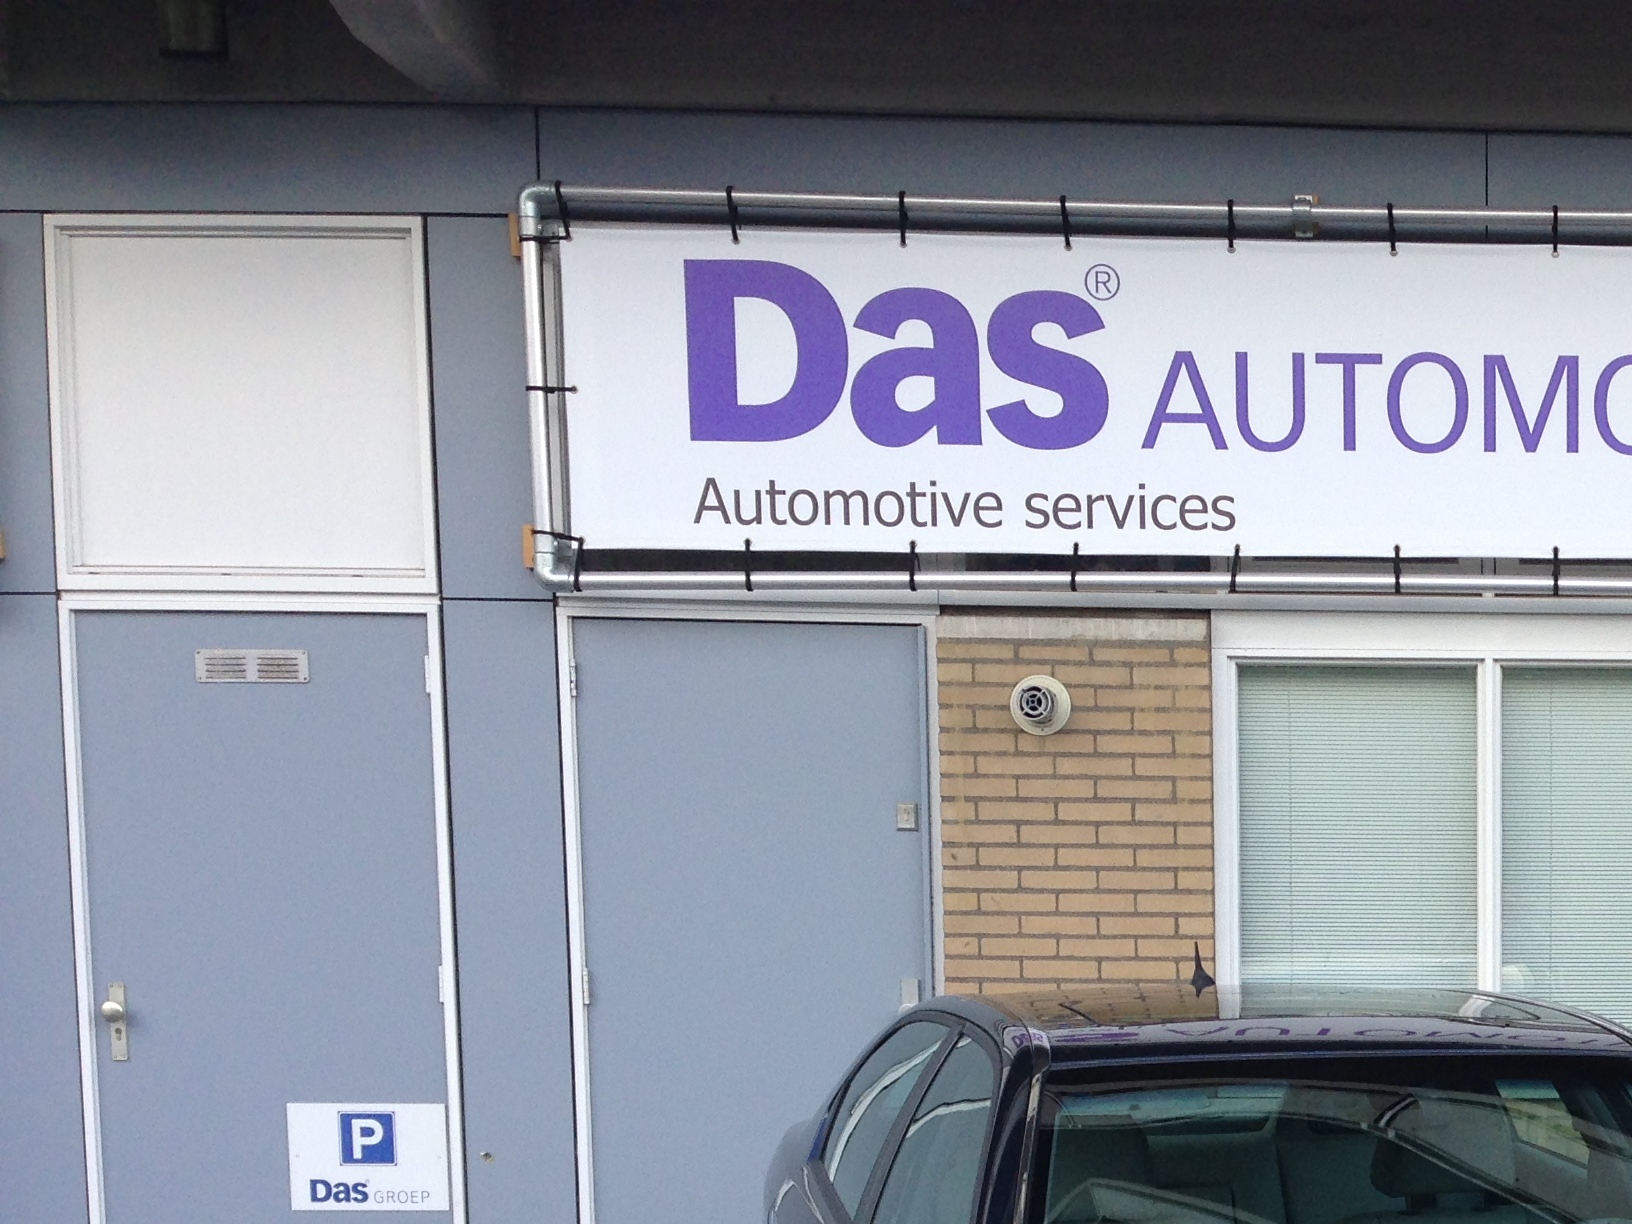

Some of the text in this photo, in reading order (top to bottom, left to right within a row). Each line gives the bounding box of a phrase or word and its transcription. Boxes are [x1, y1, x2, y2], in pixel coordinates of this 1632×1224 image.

[694, 477, 1237, 532] Automotive services
[351, 1118, 384, 1160] P
[309, 1178, 430, 1204] Das GROEP
